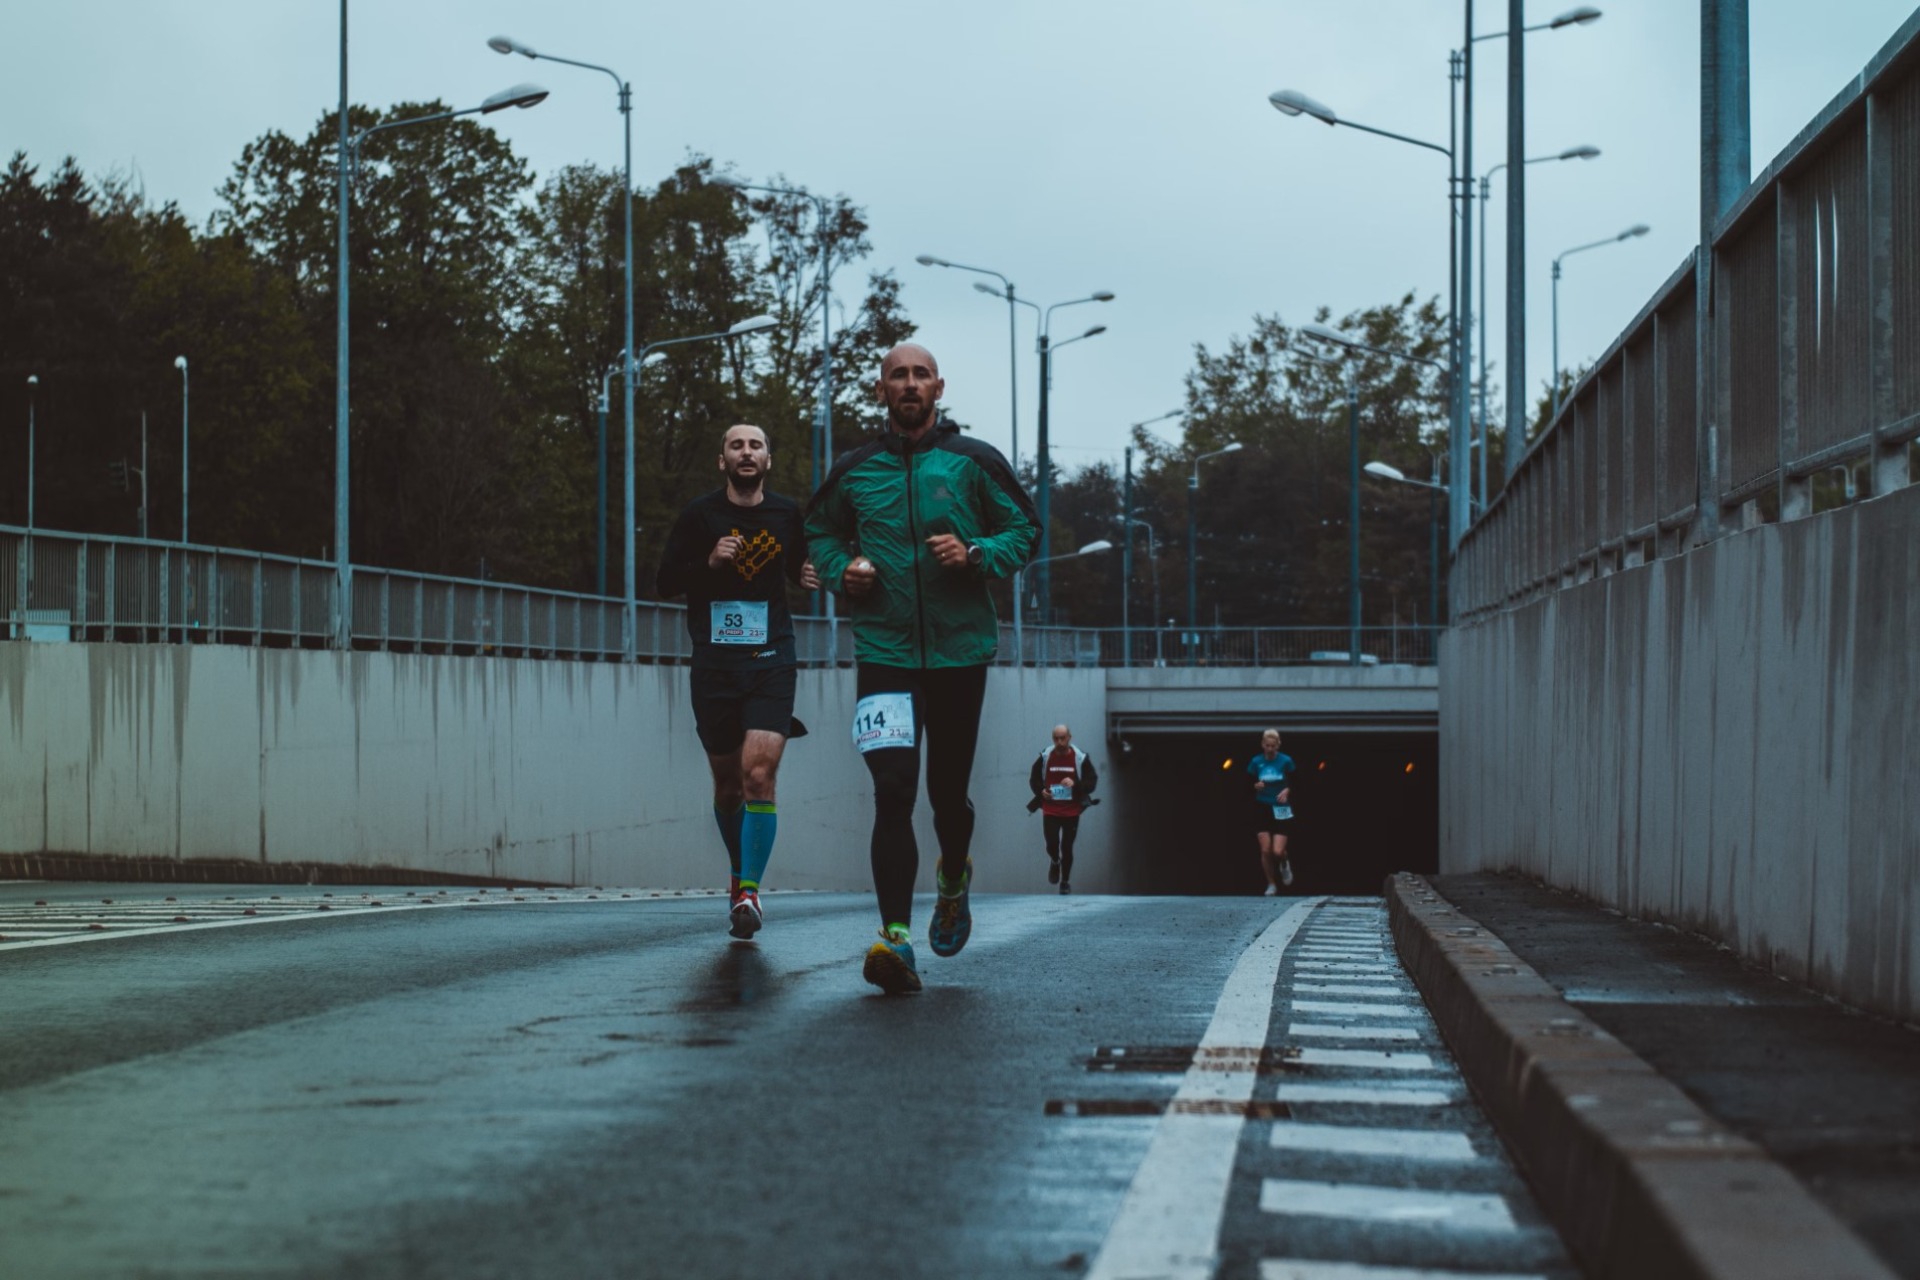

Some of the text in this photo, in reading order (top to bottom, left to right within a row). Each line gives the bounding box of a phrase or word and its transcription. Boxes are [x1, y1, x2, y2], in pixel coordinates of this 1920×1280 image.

[724, 613, 743, 627] 53
[856, 710, 886, 734] 114
[861, 730, 881, 741] PROFI
